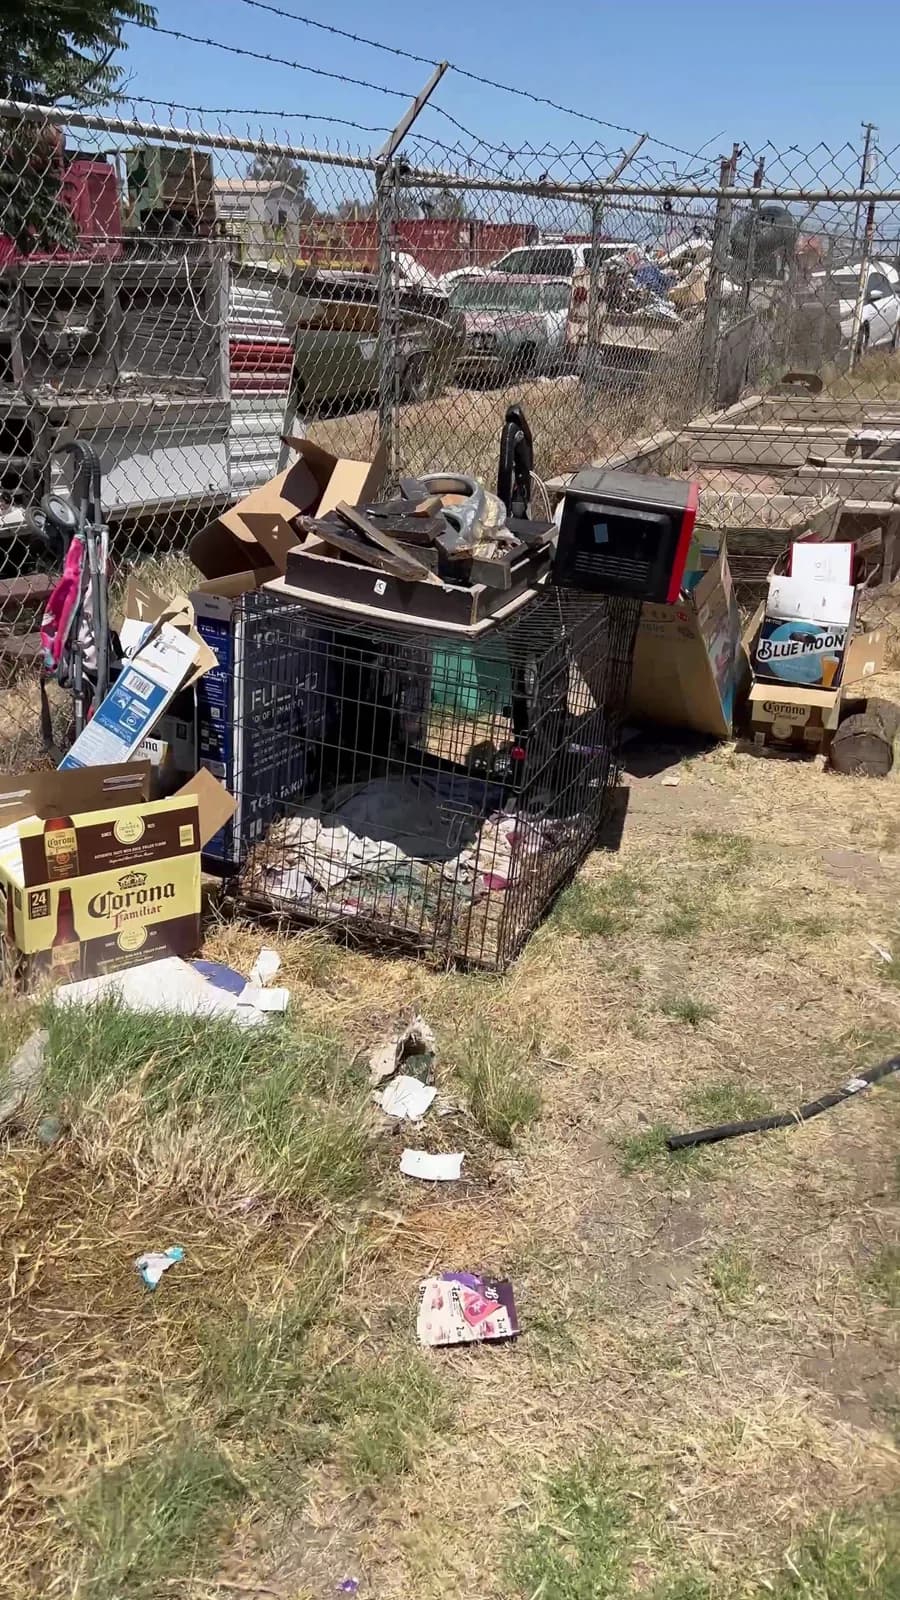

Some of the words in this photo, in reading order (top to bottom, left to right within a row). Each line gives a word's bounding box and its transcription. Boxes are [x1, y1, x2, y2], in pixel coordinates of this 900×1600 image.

[757, 640, 799, 661] BLUE
[801, 634, 845, 653] MOON
[763, 700, 806, 716] Corona
[32, 891, 47, 907] 24
[88, 882, 176, 920] Corona
[112, 903, 164, 930] Familiar
